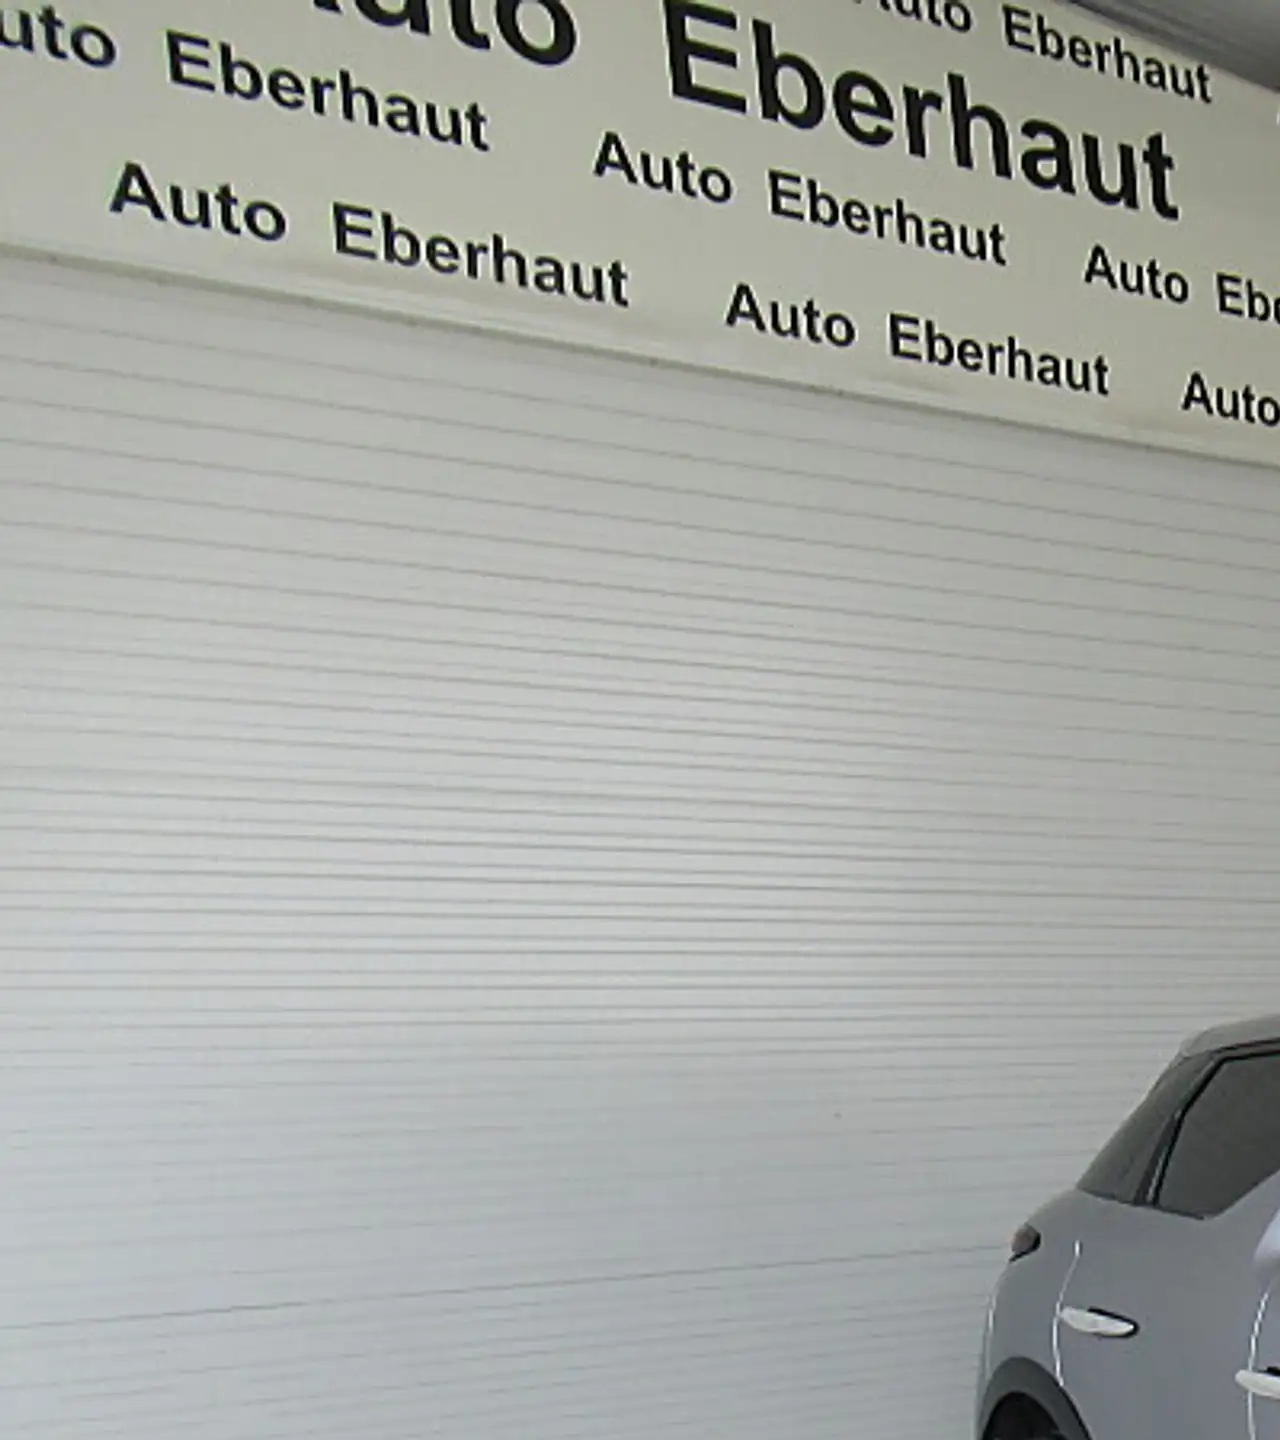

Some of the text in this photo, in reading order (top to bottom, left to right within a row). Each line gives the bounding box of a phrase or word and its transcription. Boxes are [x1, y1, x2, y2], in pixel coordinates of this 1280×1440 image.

[167, 30, 489, 151] Eberhaut
[663, 0, 1178, 220] Eberhaut
[1002, 6, 1211, 104] Eberhaut
[110, 163, 628, 307] Auto Eberhaut
[594, 132, 1006, 266] Auto Eberhaut
[1085, 245, 1188, 304] Auto
[727, 284, 1108, 395] Auto Eberhaut
[1182, 372, 1280, 426] Auto
